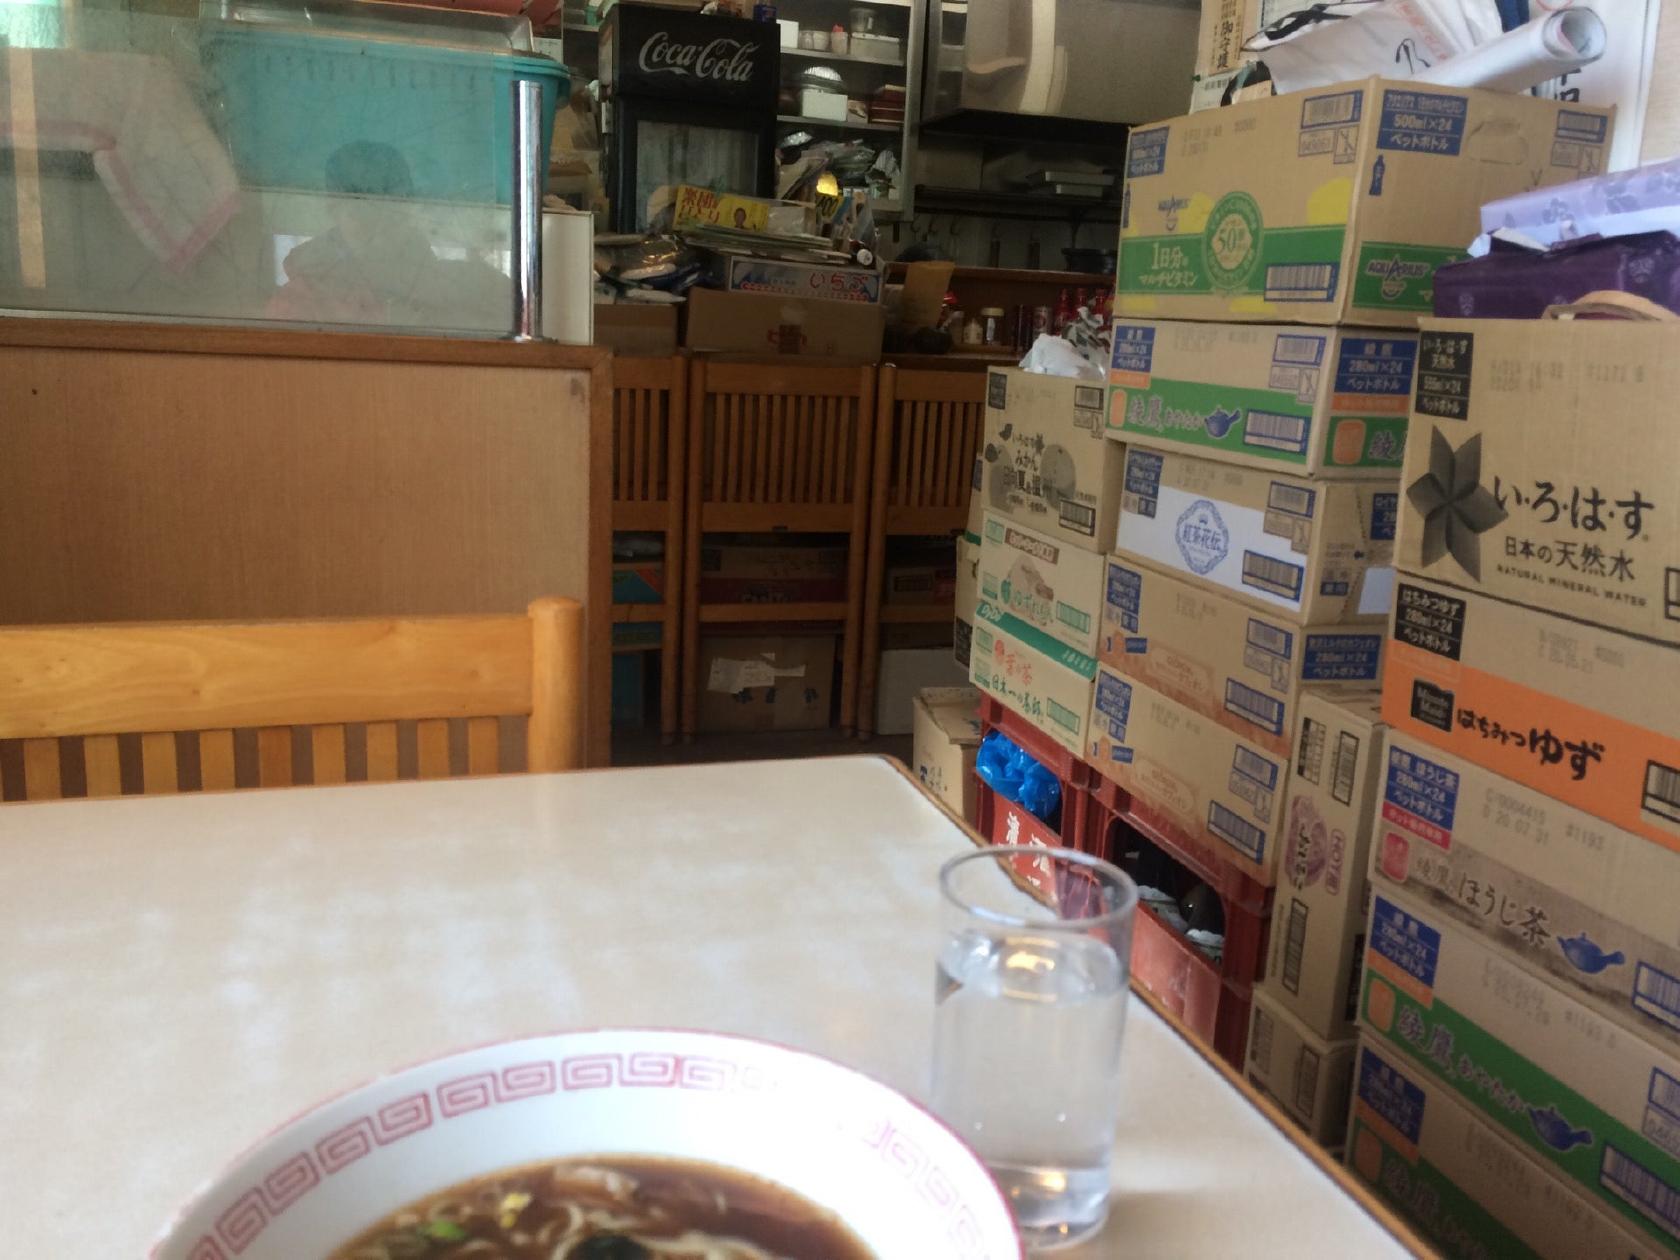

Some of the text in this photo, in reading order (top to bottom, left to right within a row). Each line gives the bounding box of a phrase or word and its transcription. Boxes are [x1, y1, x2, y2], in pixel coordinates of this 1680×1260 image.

[1390, 134, 1449, 150] ペットボトル
[1138, 271, 1199, 288] マルチビタミン
[1368, 256, 1428, 281] AQUARIUS
[1346, 376, 1400, 391] ペットボトル
[1504, 535, 1635, 583] 日本の天然水
[1496, 563, 1648, 607] NATURAL MINERAL WATER
[1402, 627, 1452, 653] ペットボトル
[1457, 707, 1606, 781] はちみつゆず
[1394, 789, 1445, 822] ペットボトル
[1458, 872, 1552, 945] ほうじ茶
